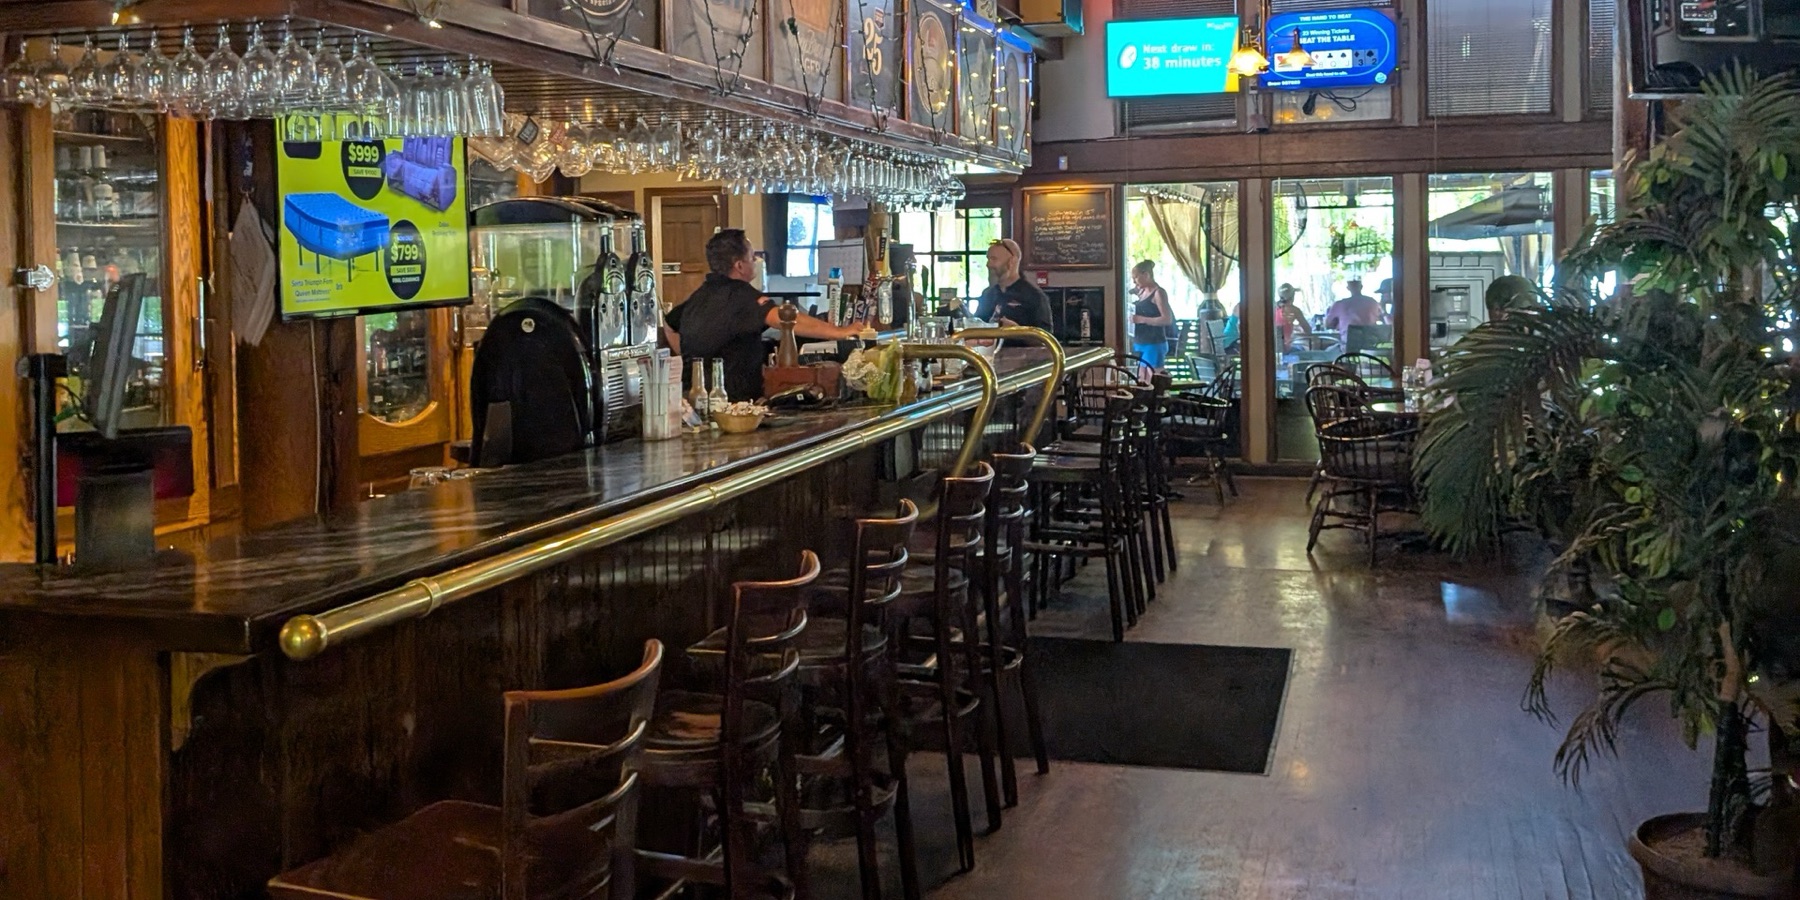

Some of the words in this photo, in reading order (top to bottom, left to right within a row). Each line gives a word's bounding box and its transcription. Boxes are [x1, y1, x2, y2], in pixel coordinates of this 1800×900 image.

[1309, 29, 1331, 37] Winning
[1332, 34, 1355, 42] TABLE
[1142, 44, 1167, 54] Next
[1171, 43, 1198, 53] draw
[1143, 56, 1160, 70] 38
[1164, 55, 1221, 69] minutes
[348, 142, 379, 163] $999
[391, 243, 418, 263] $799
